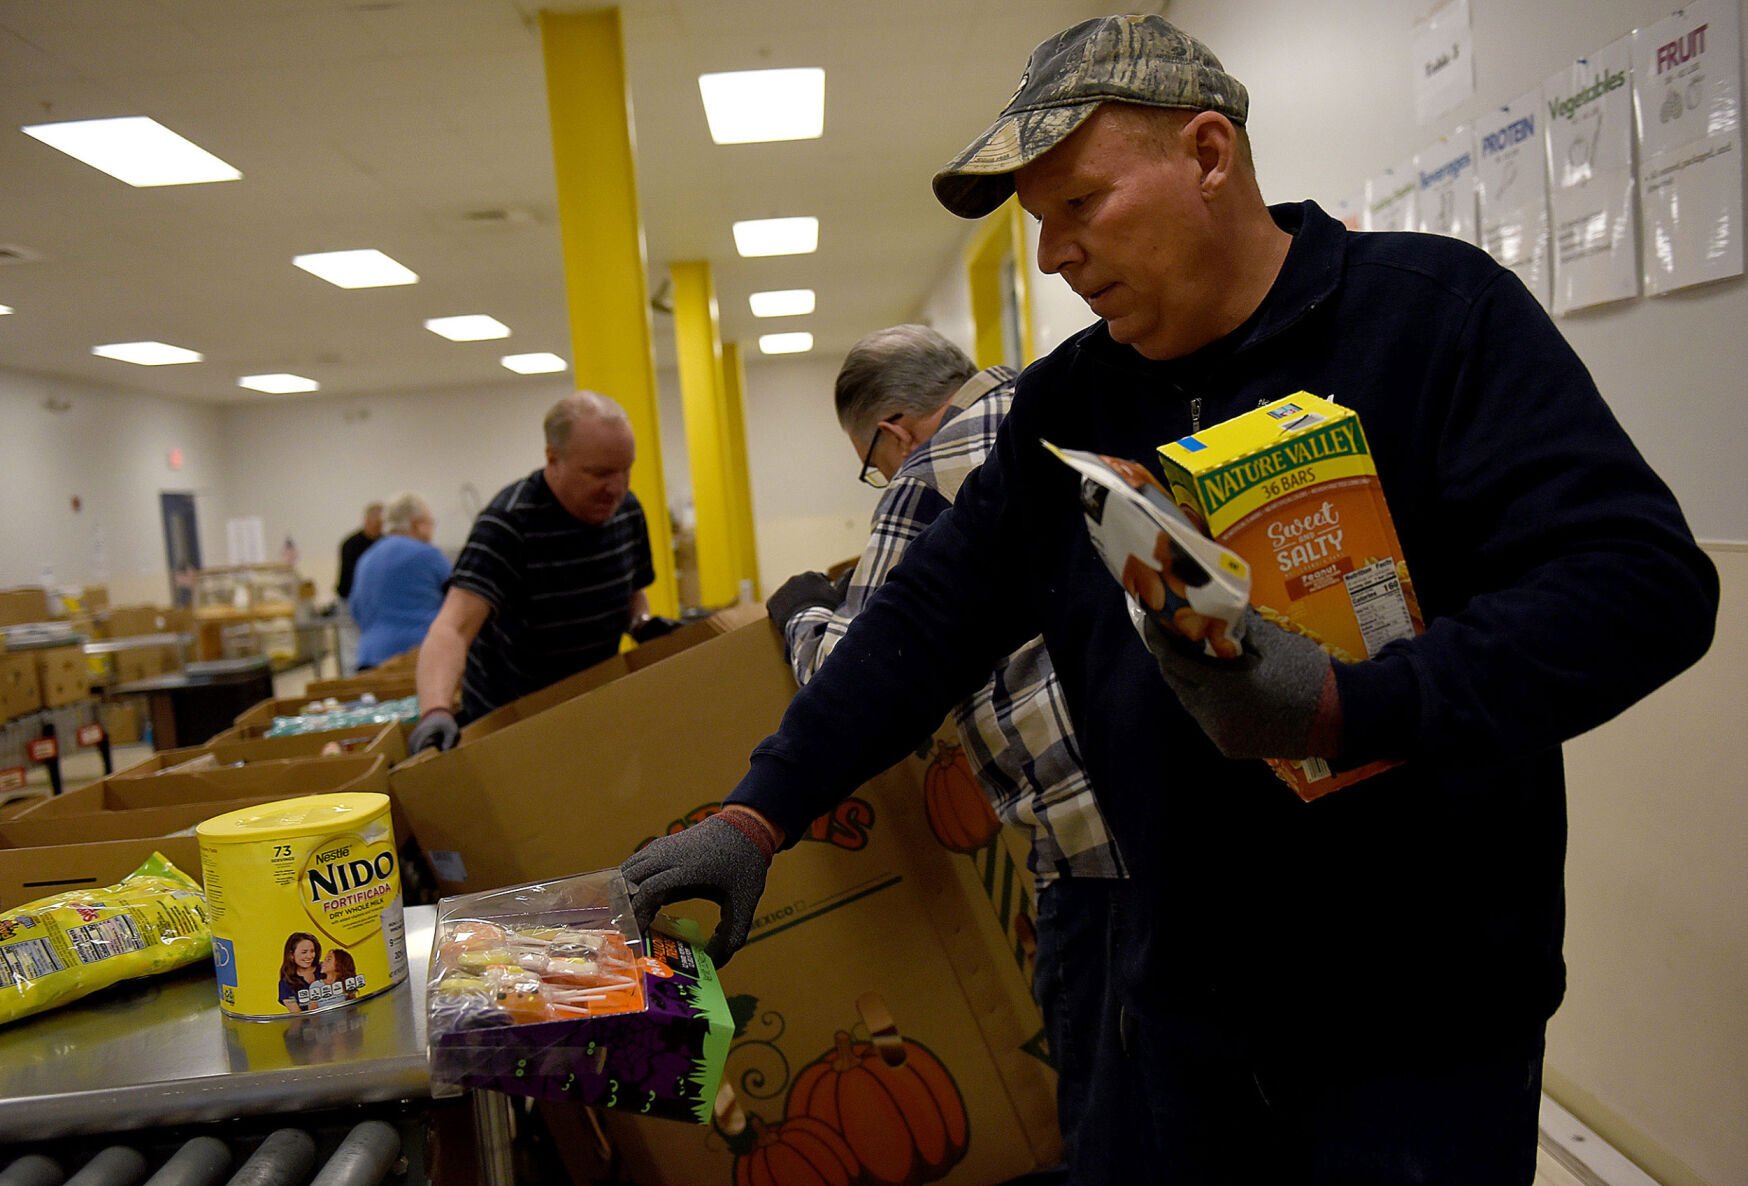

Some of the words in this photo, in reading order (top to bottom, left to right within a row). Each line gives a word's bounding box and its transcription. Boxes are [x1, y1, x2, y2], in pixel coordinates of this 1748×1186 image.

[1655, 23, 1710, 76] FRUIT
[1548, 69, 1627, 121] Vegetables
[1482, 114, 1536, 158] PROTEIN
[1203, 454, 1287, 512] NATURE
[1284, 422, 1360, 466] VALLEY
[1263, 482, 1281, 500] 36
[1281, 467, 1317, 491] BARS
[1267, 501, 1341, 549] Sweet
[1277, 529, 1344, 573] SALTY
[1302, 564, 1338, 583] Peanut
[273, 845, 292, 858] 73
[307, 850, 394, 902] NIDO
[323, 882, 392, 912] FORTIFICADA
[329, 910, 345, 920] DRY
[345, 902, 370, 917] WHOLE
[370, 897, 385, 909] MILK
